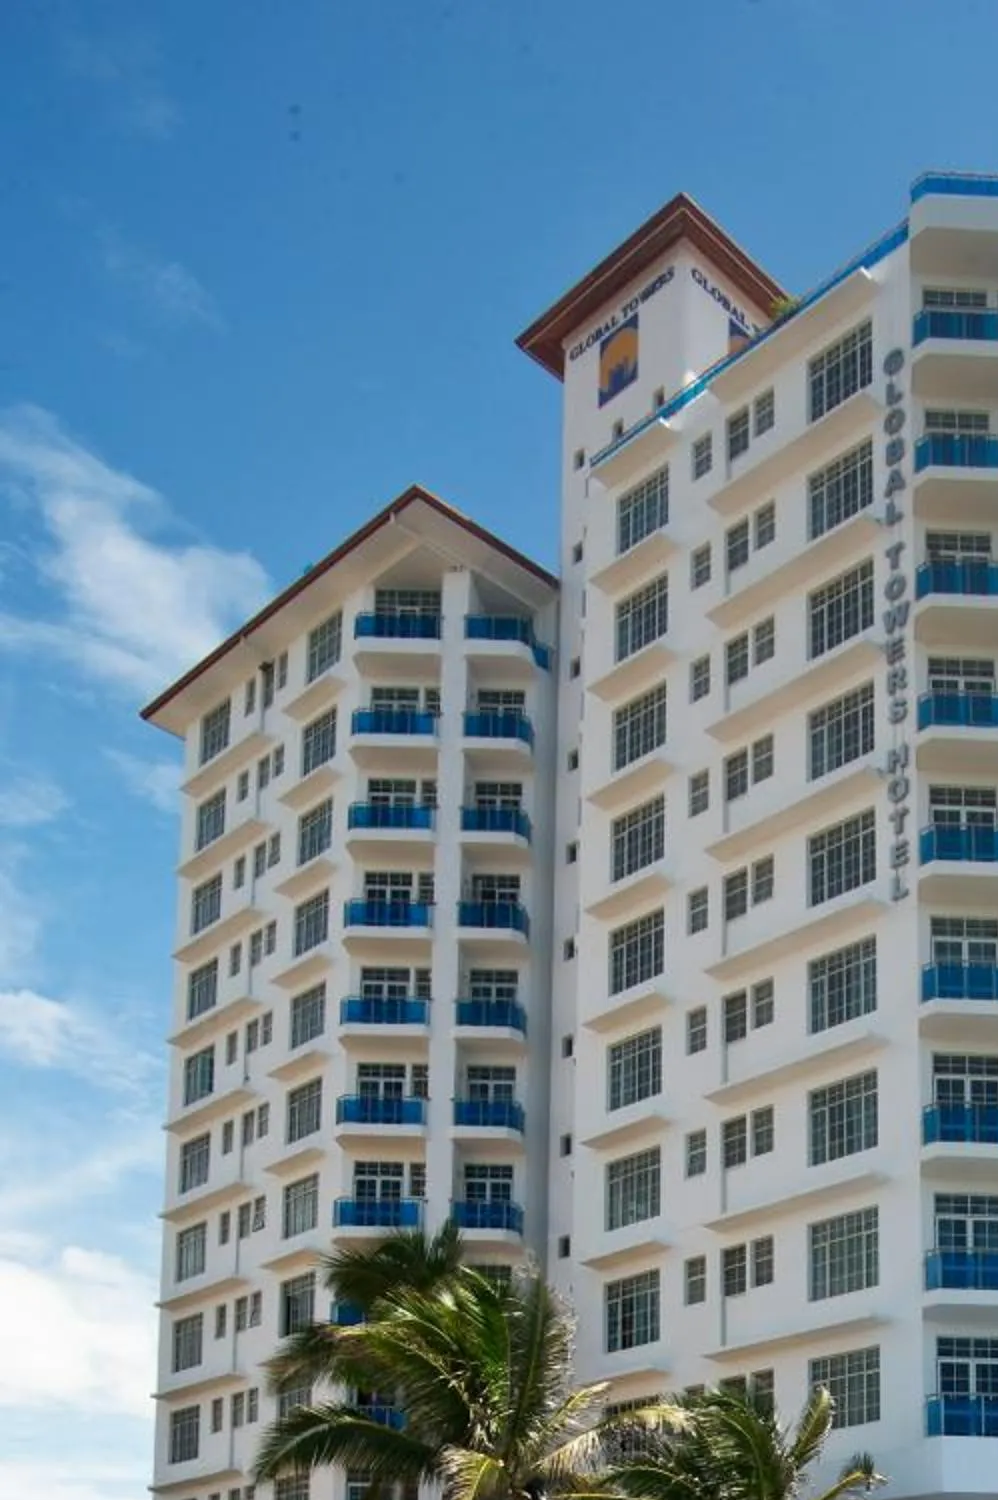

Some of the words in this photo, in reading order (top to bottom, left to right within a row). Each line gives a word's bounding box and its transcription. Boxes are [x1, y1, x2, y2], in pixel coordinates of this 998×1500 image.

[569, 315, 618, 361] GLOBAL
[621, 266, 675, 318] TOWERS
[691, 268, 750, 331] GLOBAL
[883, 348, 906, 527] GLOBAL
[883, 541, 910, 725] TOWERS
[887, 742, 910, 902] HOTEL
